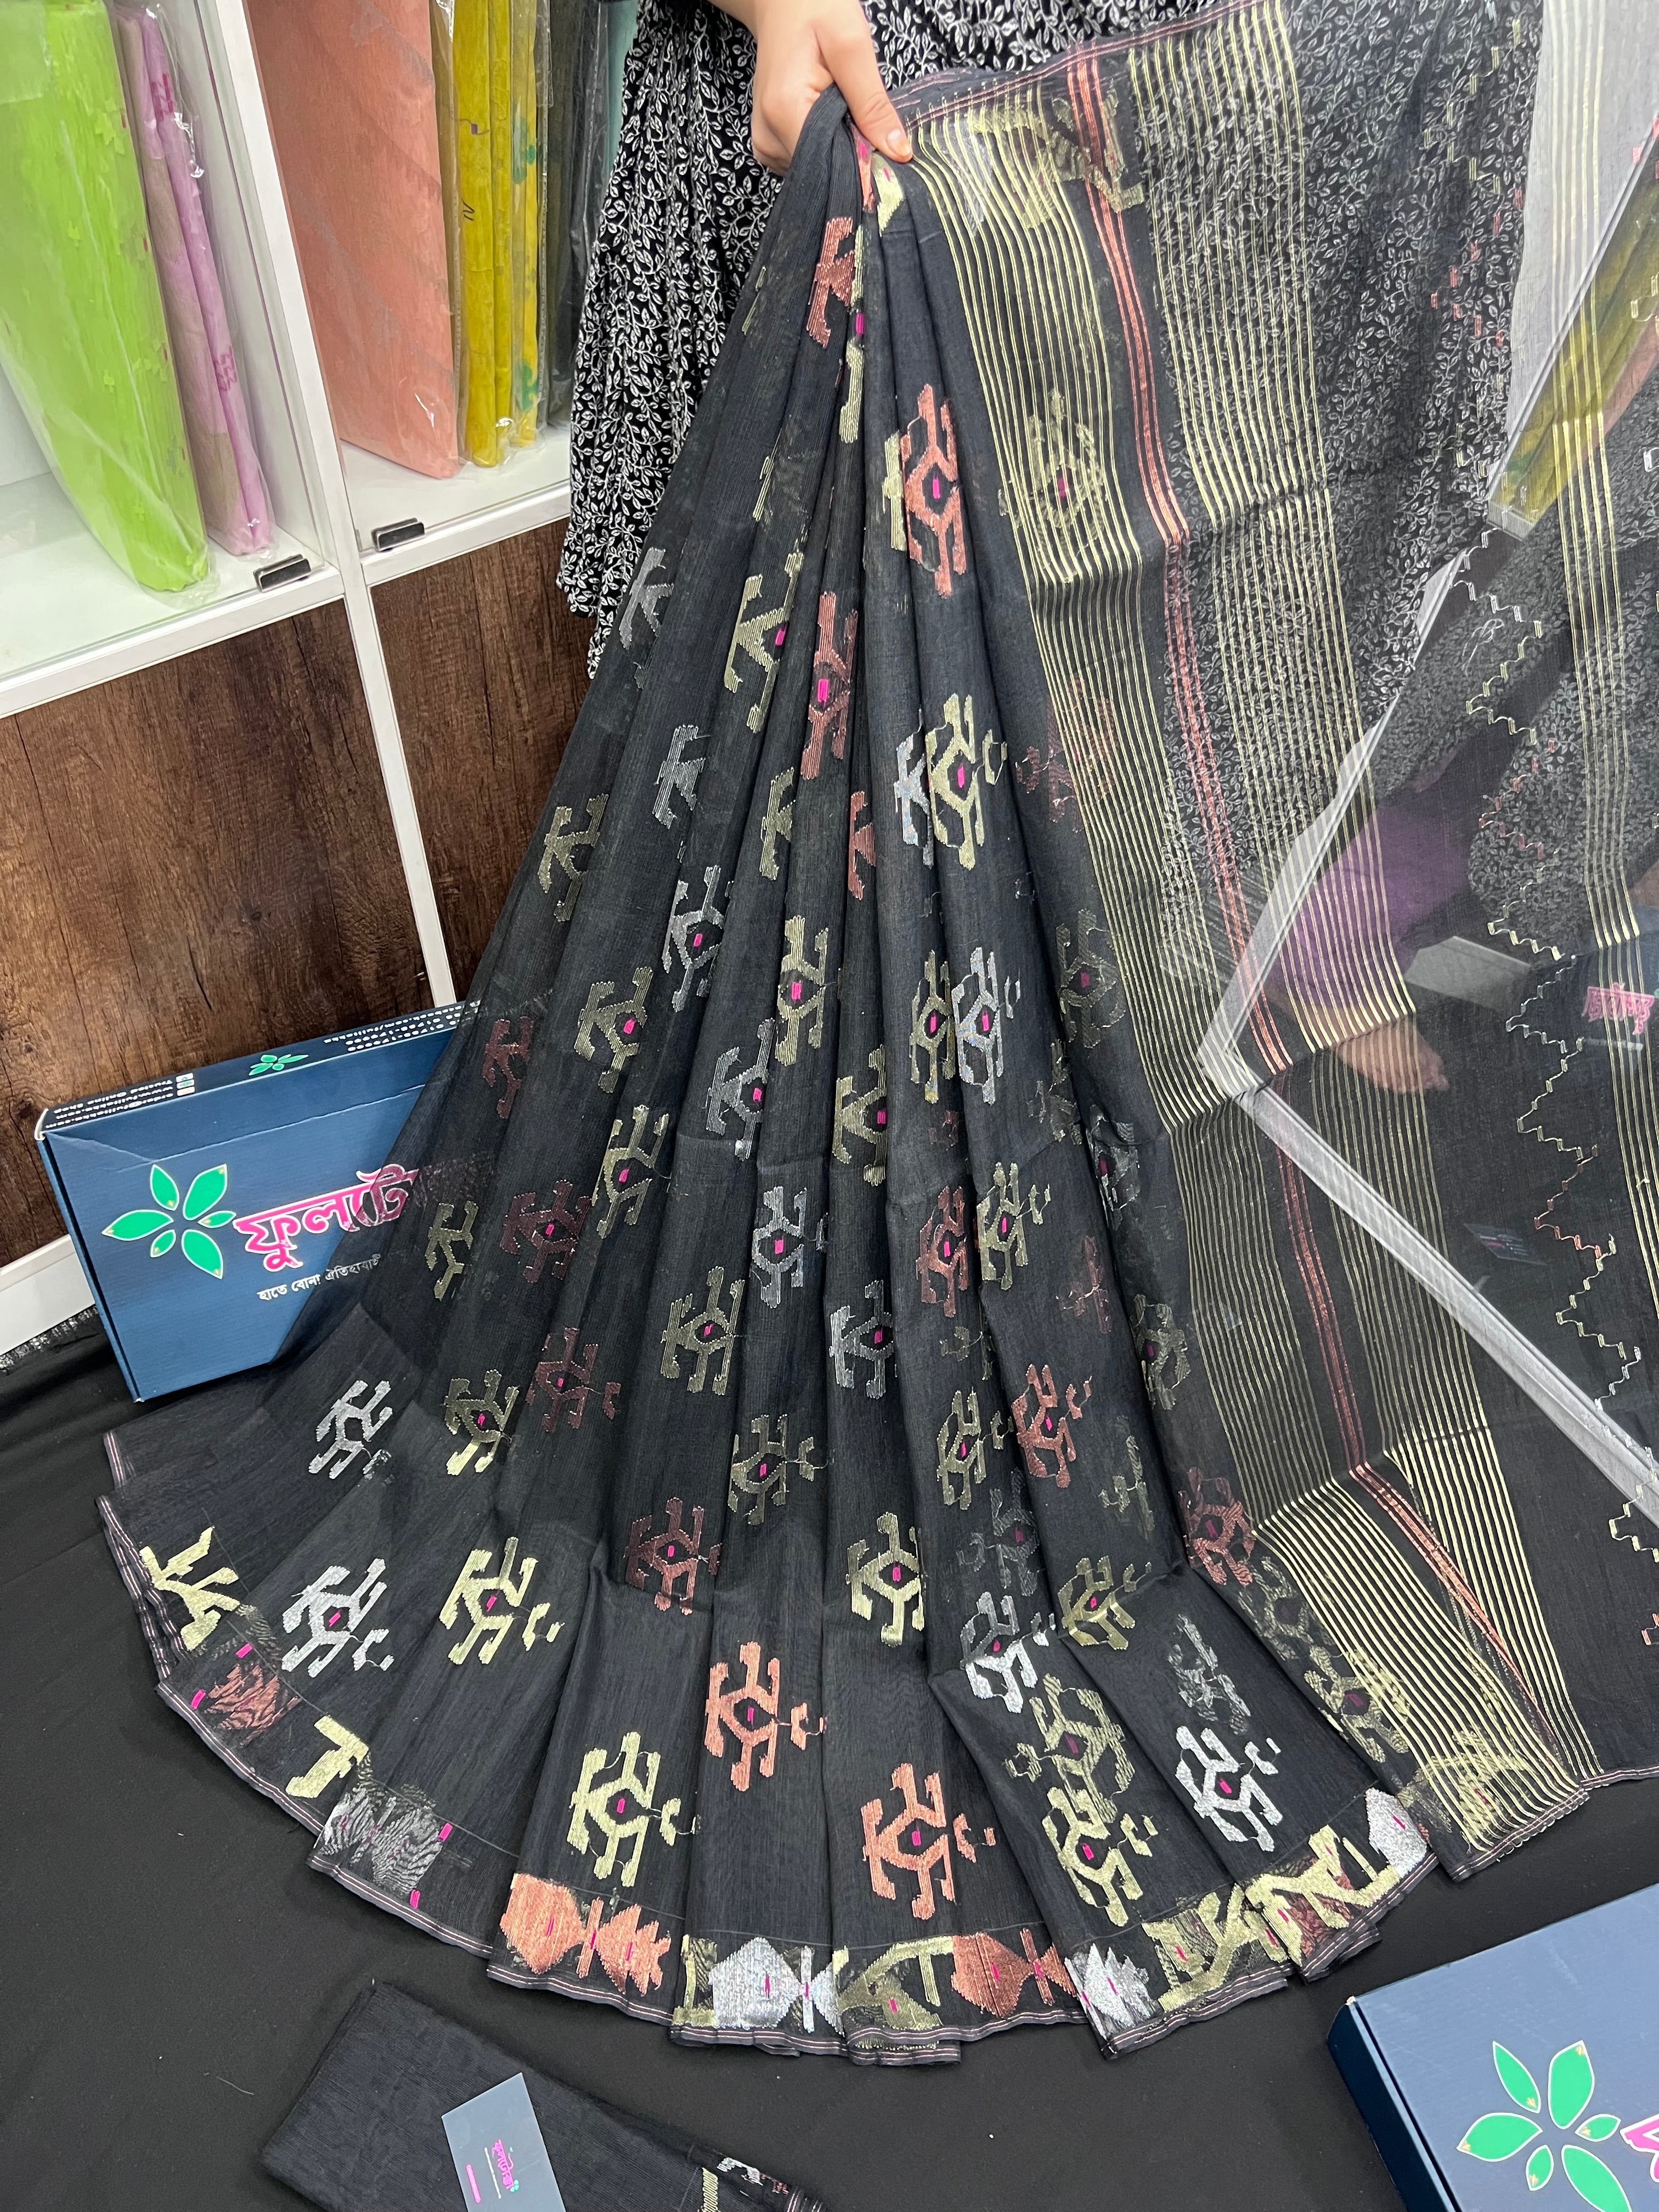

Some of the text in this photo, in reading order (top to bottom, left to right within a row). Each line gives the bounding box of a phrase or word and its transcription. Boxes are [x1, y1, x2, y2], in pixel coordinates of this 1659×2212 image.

[54, 1079, 173, 1114] Trusted Online Shop
[257, 1284, 287, 1301] হাতে
[291, 1274, 320, 1292] বোনা
